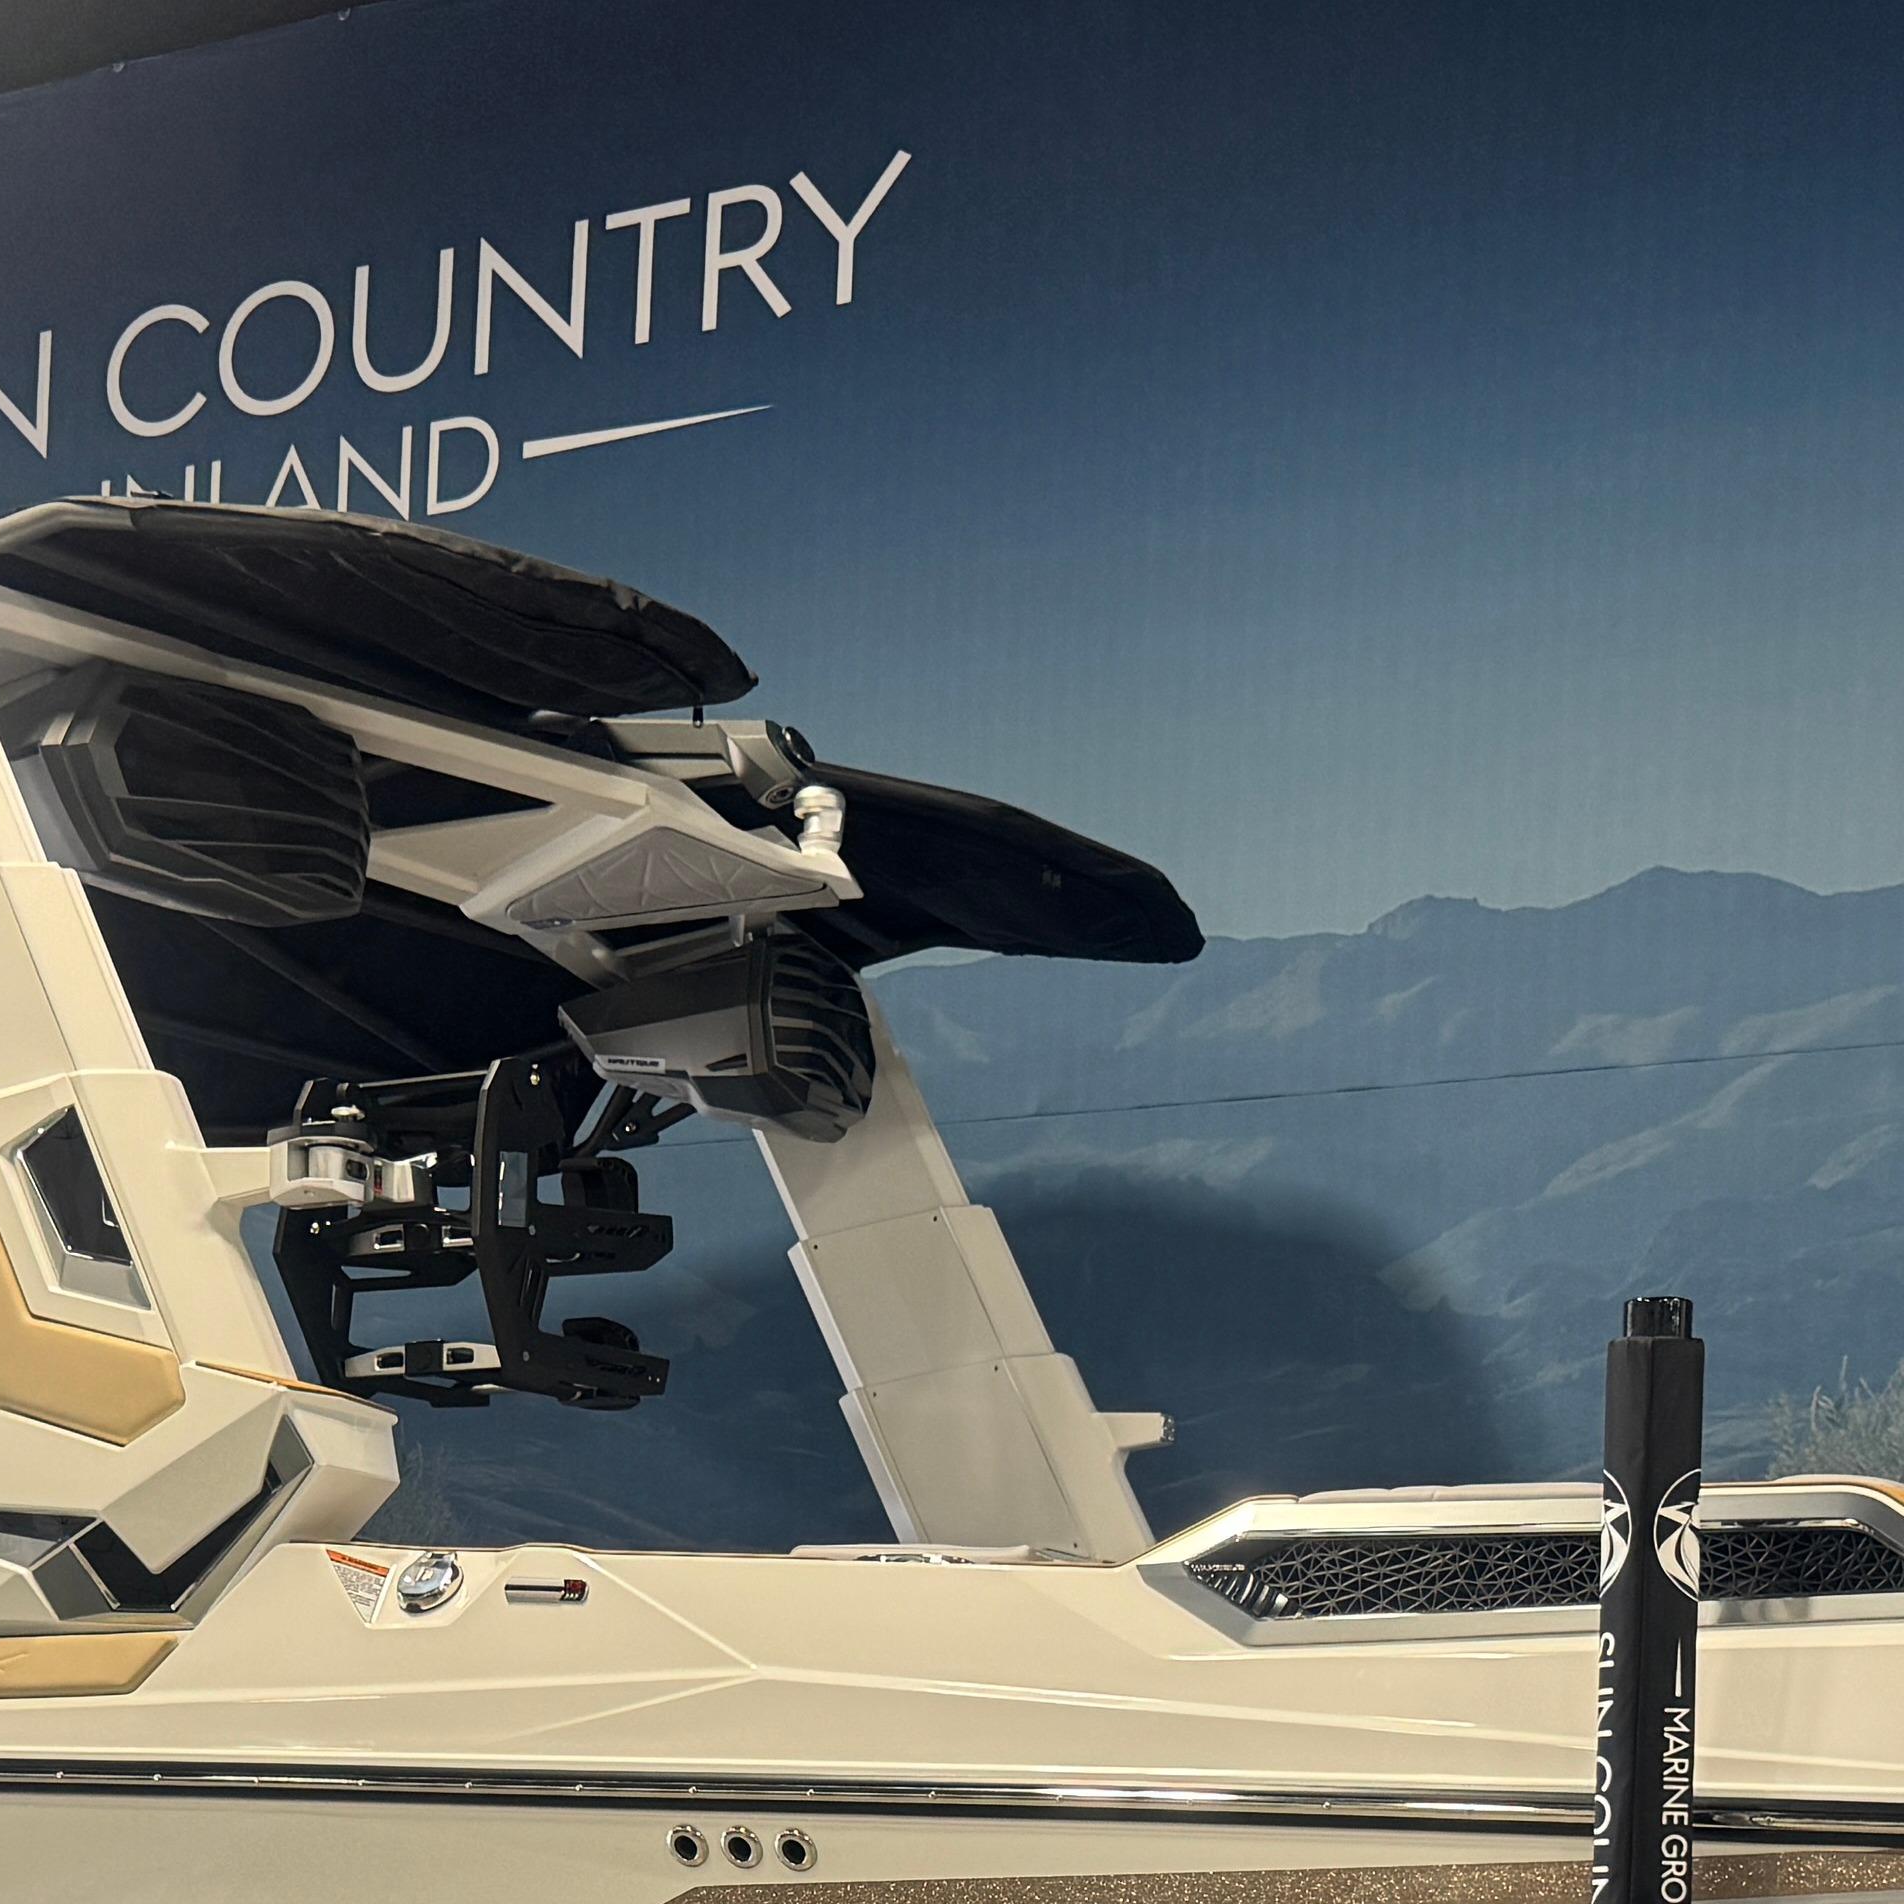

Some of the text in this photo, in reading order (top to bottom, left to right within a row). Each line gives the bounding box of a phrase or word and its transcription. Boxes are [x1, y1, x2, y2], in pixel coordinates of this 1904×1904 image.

[106, 149, 913, 438] COUNTRY
[100, 415, 500, 522] AND
[1661, 1706, 1691, 1826] MARINE
